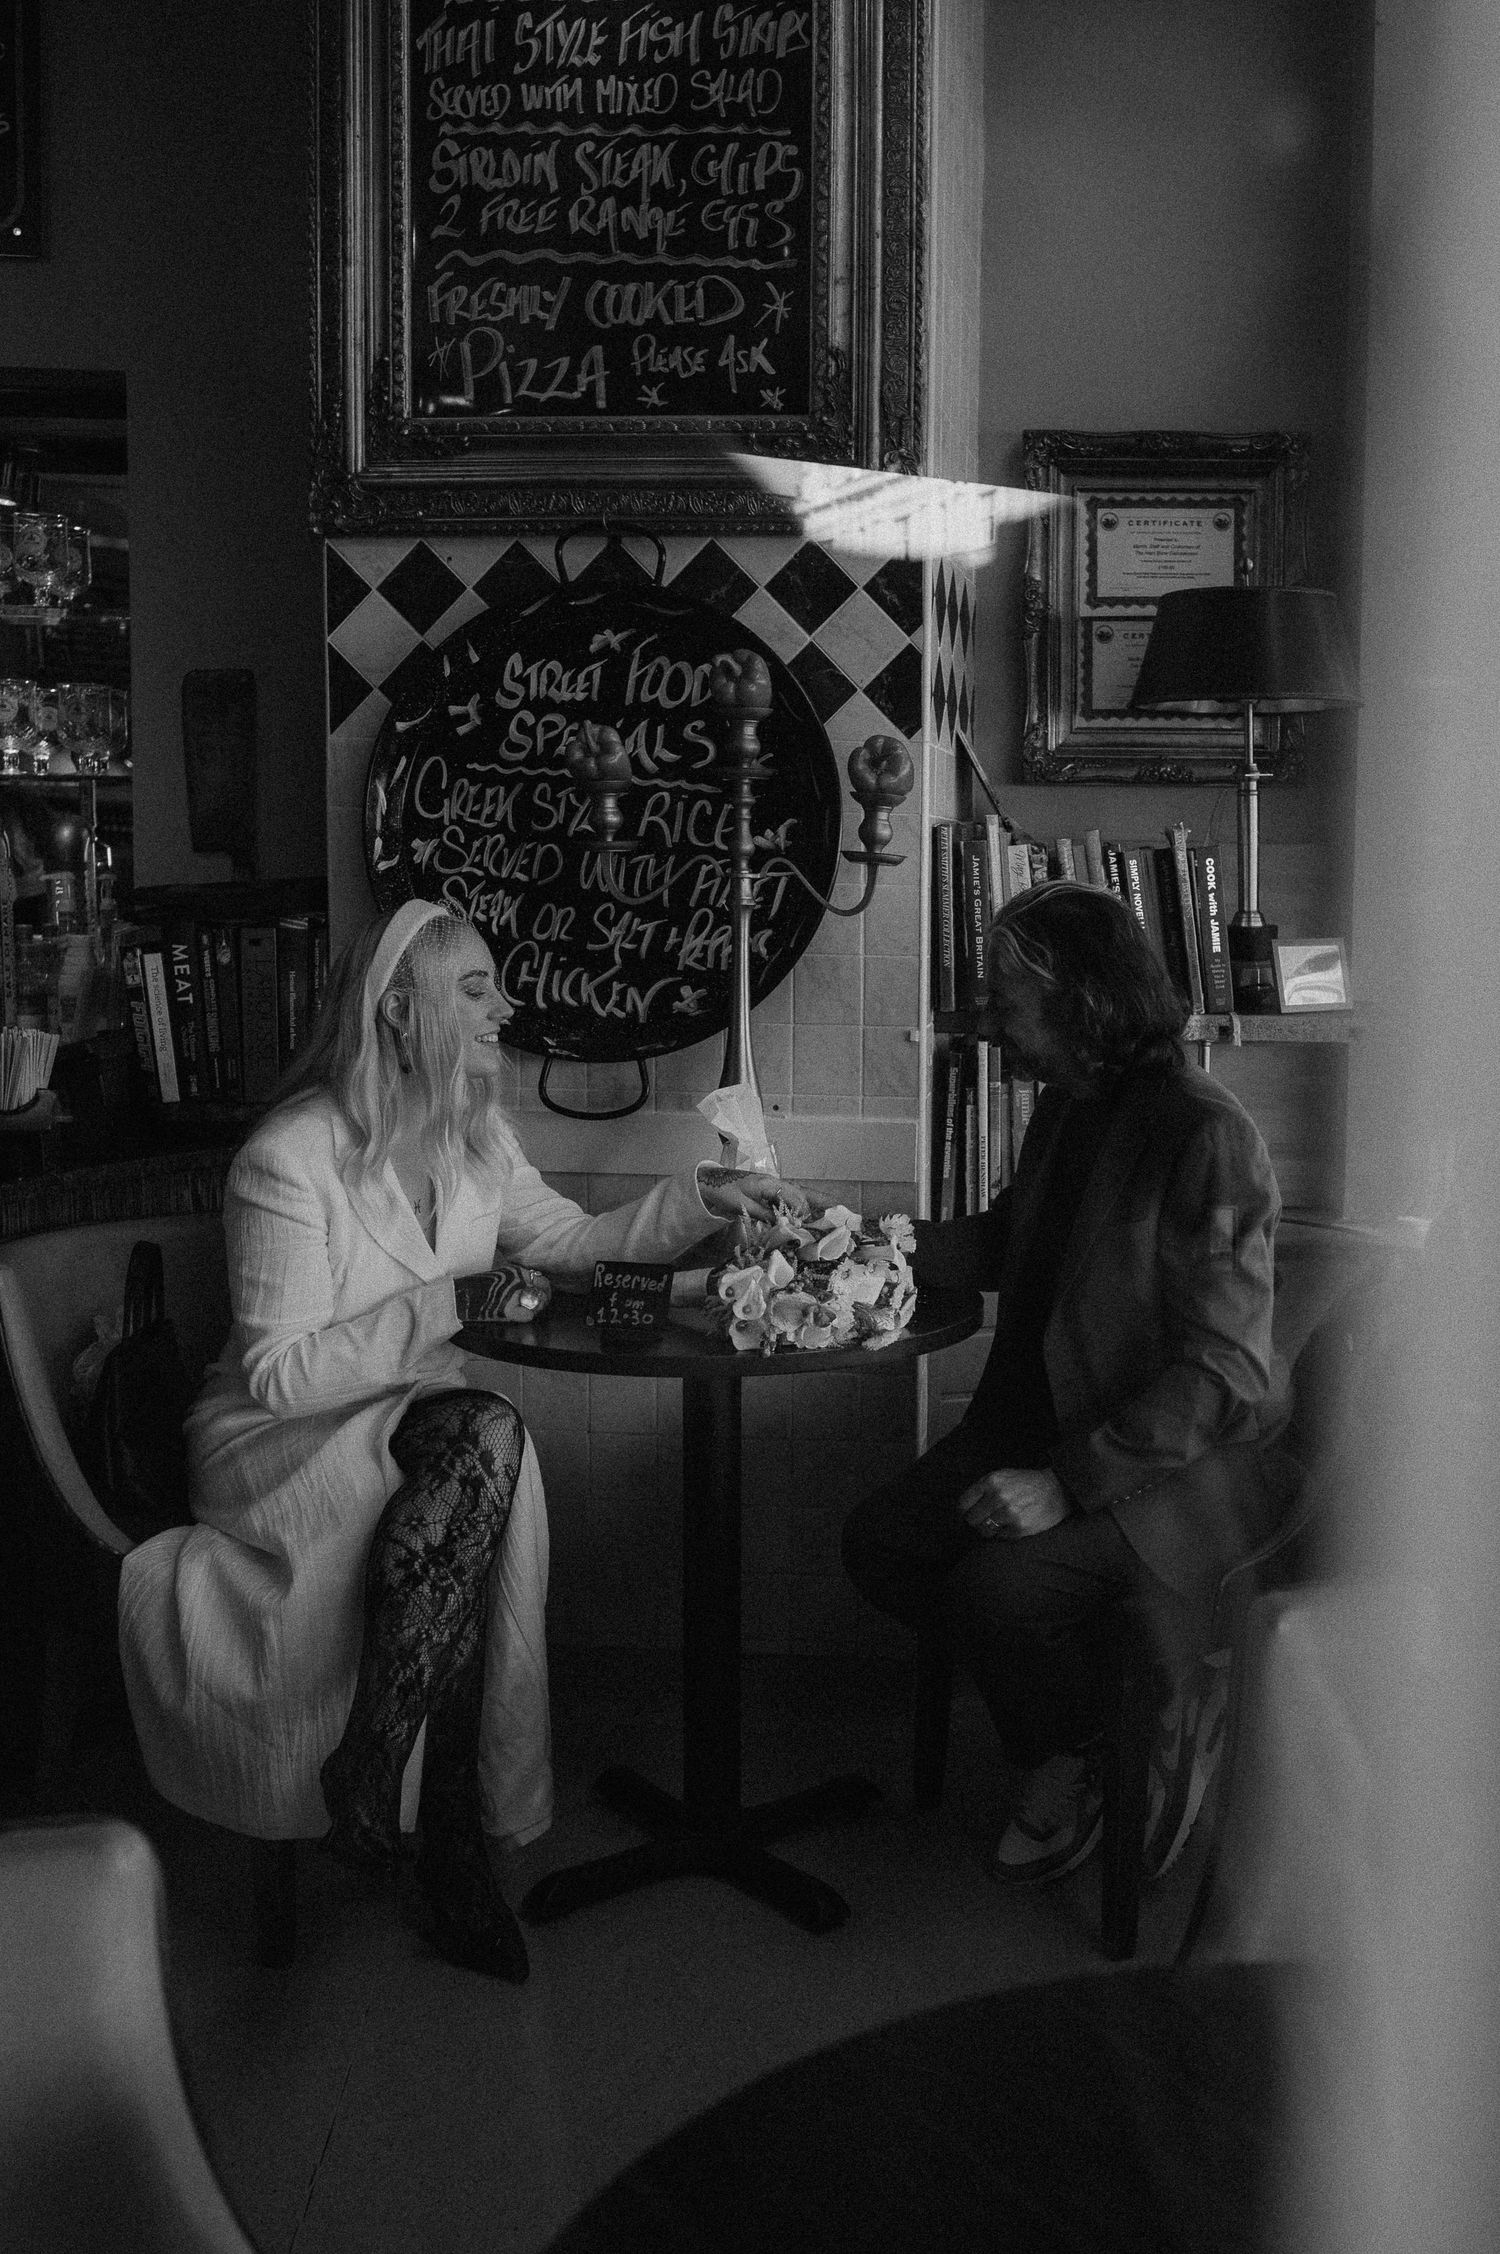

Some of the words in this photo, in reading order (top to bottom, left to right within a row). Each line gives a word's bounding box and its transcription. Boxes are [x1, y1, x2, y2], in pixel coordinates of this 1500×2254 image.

[416, 6, 500, 78] THAI
[513, 3, 609, 74] STYLE
[619, 2, 703, 66] FISH
[427, 76, 511, 121] SERVED
[522, 74, 584, 114] WITH
[596, 72, 678, 115] MIXED
[690, 67, 783, 117] SALAD
[691, 140, 802, 202] CHIPS
[430, 194, 466, 238] 2
[480, 193, 559, 237] FREE
[569, 195, 693, 253] RANGE
[702, 199, 797, 249] EGGS
[427, 272, 572, 331] FRESHLY
[585, 275, 745, 328] COOKED
[460, 326, 611, 408] PIZZA
[631, 334, 706, 378] PLEASE
[718, 335, 777, 393] ASK
[1127, 519, 1203, 528] CERTIFICATE
[495, 652, 609, 709] STREET
[499, 709, 717, 773] SPEALS
[414, 756, 523, 833] GREEK
[531, 782, 596, 837] STYL
[433, 824, 564, 885] SERVED
[972, 855, 981, 896] JAMIE'S
[1107, 849, 1121, 893] JAMIE'S
[1128, 859, 1141, 891] SIMPLY
[1205, 857, 1217, 890] COOK
[441, 875, 524, 939] STEAK
[532, 902, 575, 942] OR
[587, 901, 669, 965] SALT
[974, 899, 982, 933] GREAT
[1208, 893, 1219, 916] with
[942, 918, 951, 967] COLLECTION
[975, 937, 984, 979] BRITAIN
[1210, 919, 1222, 953] JAMIE
[151, 965, 160, 983] The
[171, 944, 194, 1005] MEAT
[501, 941, 683, 1023] CHICKEN
[153, 985, 163, 1016] science
[158, 1028, 169, 1052] living
[1018, 1088, 1033, 1125] jamie
[593, 1263, 668, 1292] Reserved
